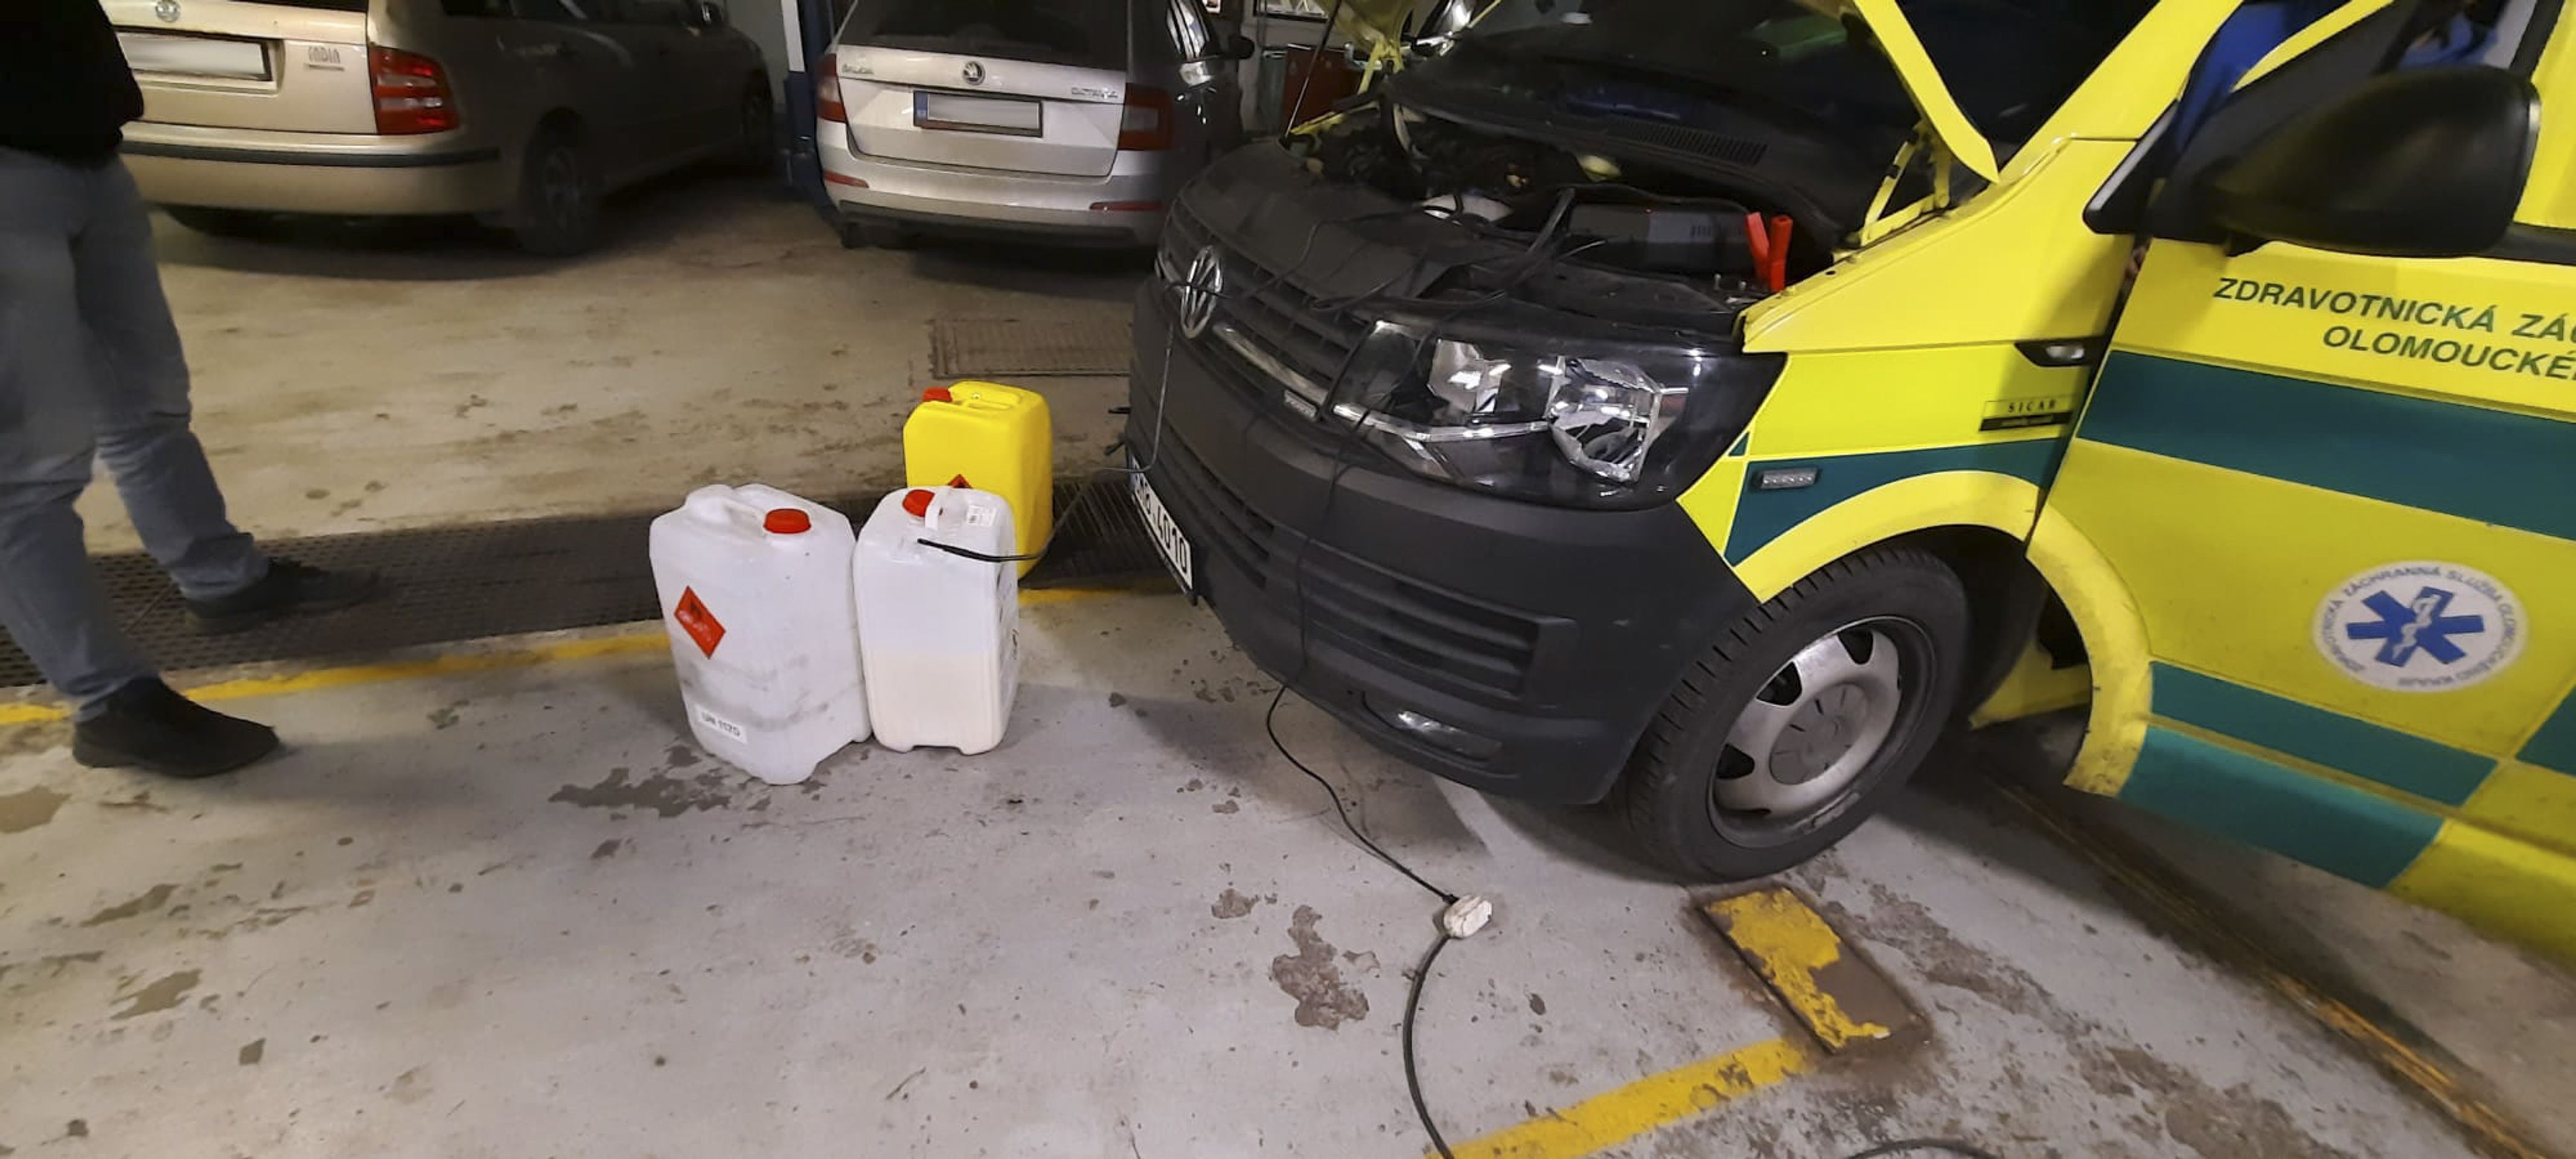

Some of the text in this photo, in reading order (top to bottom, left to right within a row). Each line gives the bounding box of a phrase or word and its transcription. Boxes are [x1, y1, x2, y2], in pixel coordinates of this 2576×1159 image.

[2213, 277, 2576, 343] ZDRAVOTNICKÁ ZÁ
[2324, 325, 2576, 380] OLOMOUCKÉ
[2009, 400, 2056, 413] SICAR
